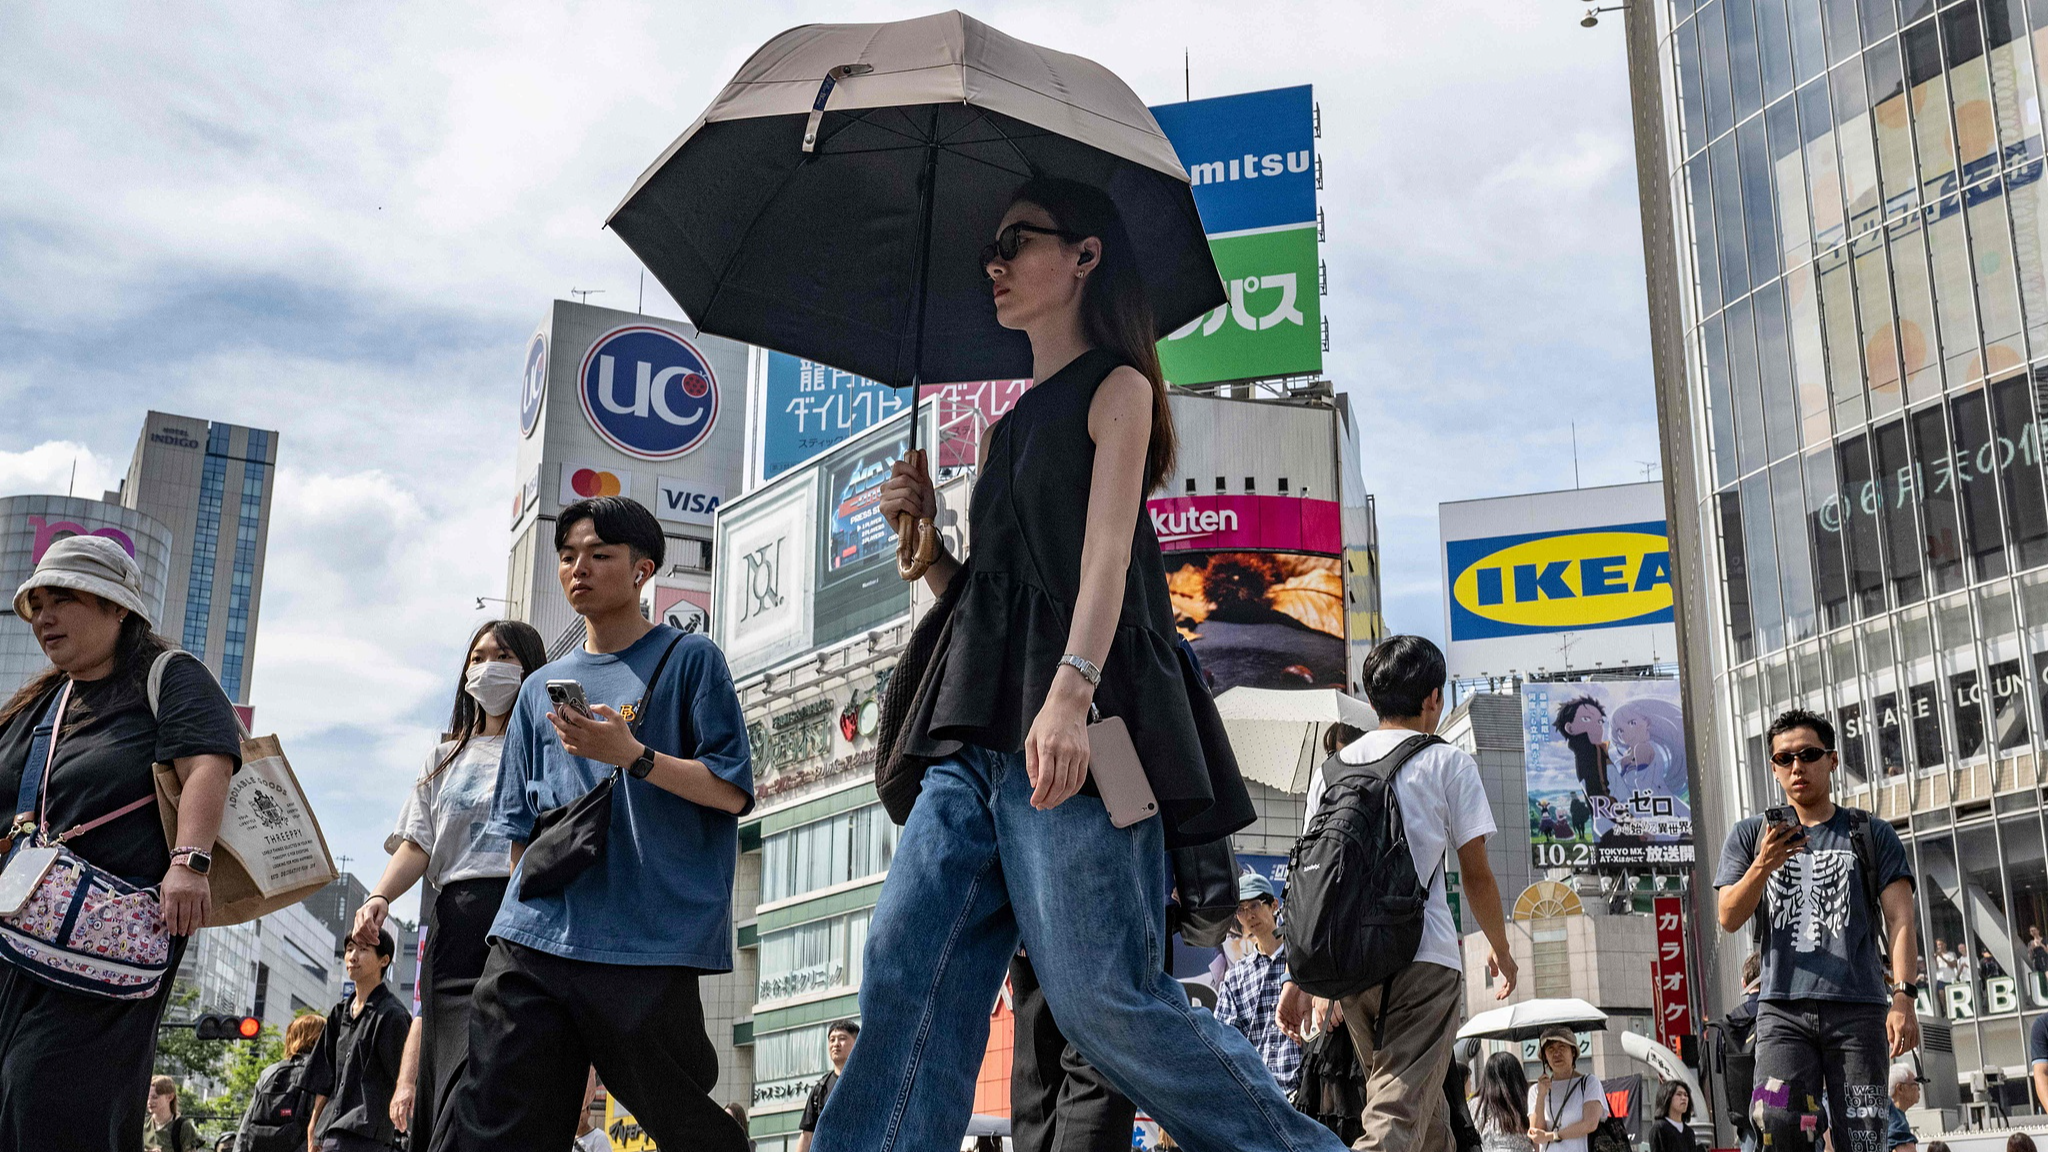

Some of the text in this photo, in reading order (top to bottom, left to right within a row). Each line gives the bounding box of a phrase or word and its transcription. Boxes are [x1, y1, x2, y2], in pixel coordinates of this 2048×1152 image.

[1190, 149, 1310, 186] mitsu
[1167, 272, 1304, 341] パス
[151, 433, 199, 449] INDIGO
[163, 427, 189, 437] HOTEL
[661, 488, 720, 514] VISA
[850, 509, 872, 525] PRESS
[1476, 550, 1673, 607] IKEA
[229, 776, 257, 810] ADORABLE
[257, 777, 288, 796] GOODS
[264, 828, 304, 845] THREEPPY
[1536, 843, 1590, 866] 10.2
[1646, 845, 1696, 862] 放送開
[1658, 912, 1687, 1022] カラオケ
[1845, 1095, 1861, 1107] to
[1848, 1127, 1878, 1141] love
